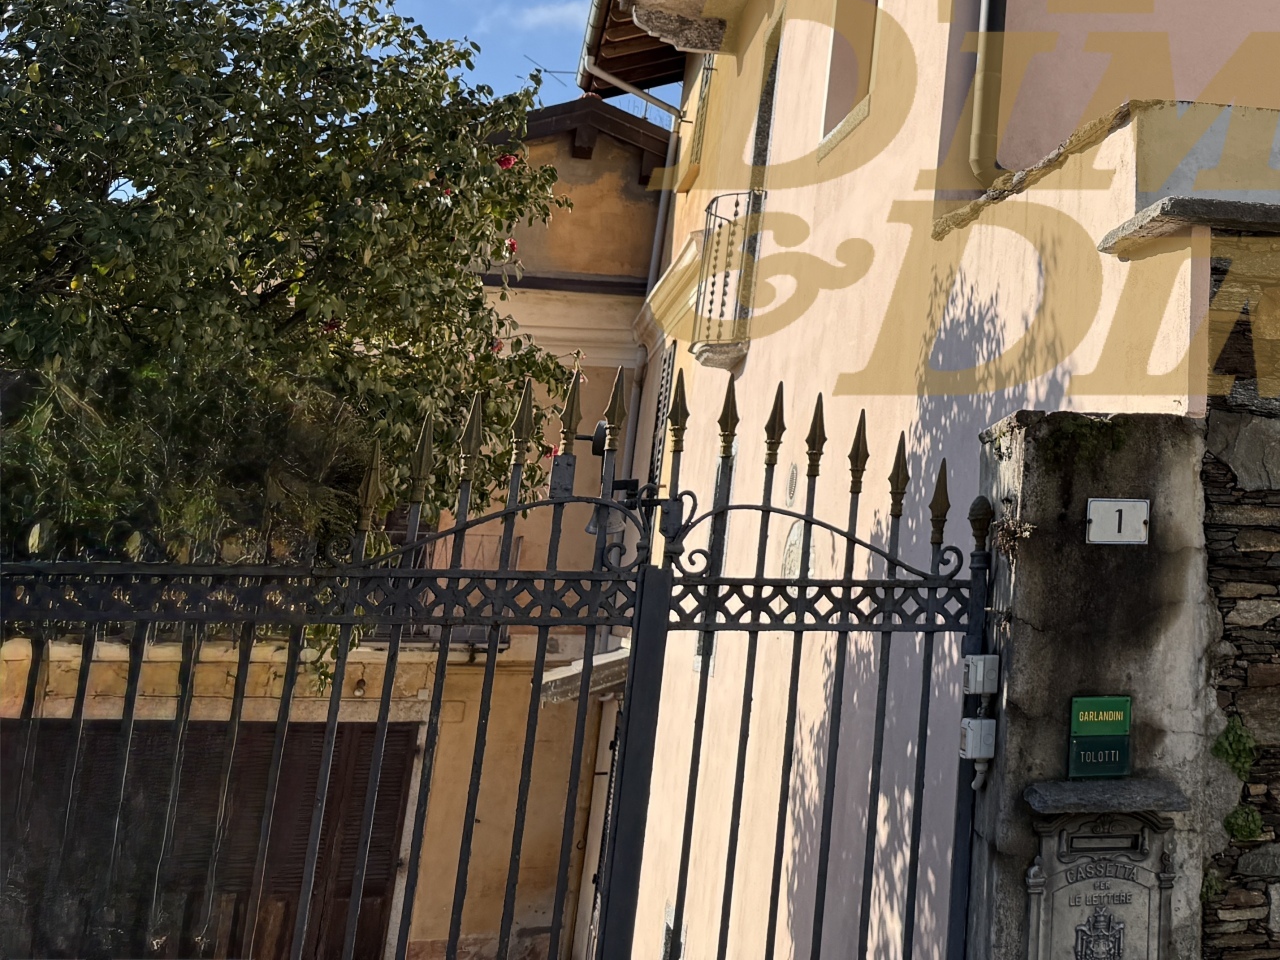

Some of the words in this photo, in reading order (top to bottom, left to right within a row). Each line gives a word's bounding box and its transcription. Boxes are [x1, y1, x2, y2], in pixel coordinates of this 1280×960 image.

[1115, 508, 1123, 534] 1
[1079, 710, 1124, 722] GARLANDINI
[1080, 750, 1119, 763] TOLOTTI
[1066, 862, 1139, 885] CASSETTA
[1093, 881, 1111, 891] PER
[1069, 895, 1082, 907] LE
[1085, 892, 1133, 907] LETTERE
